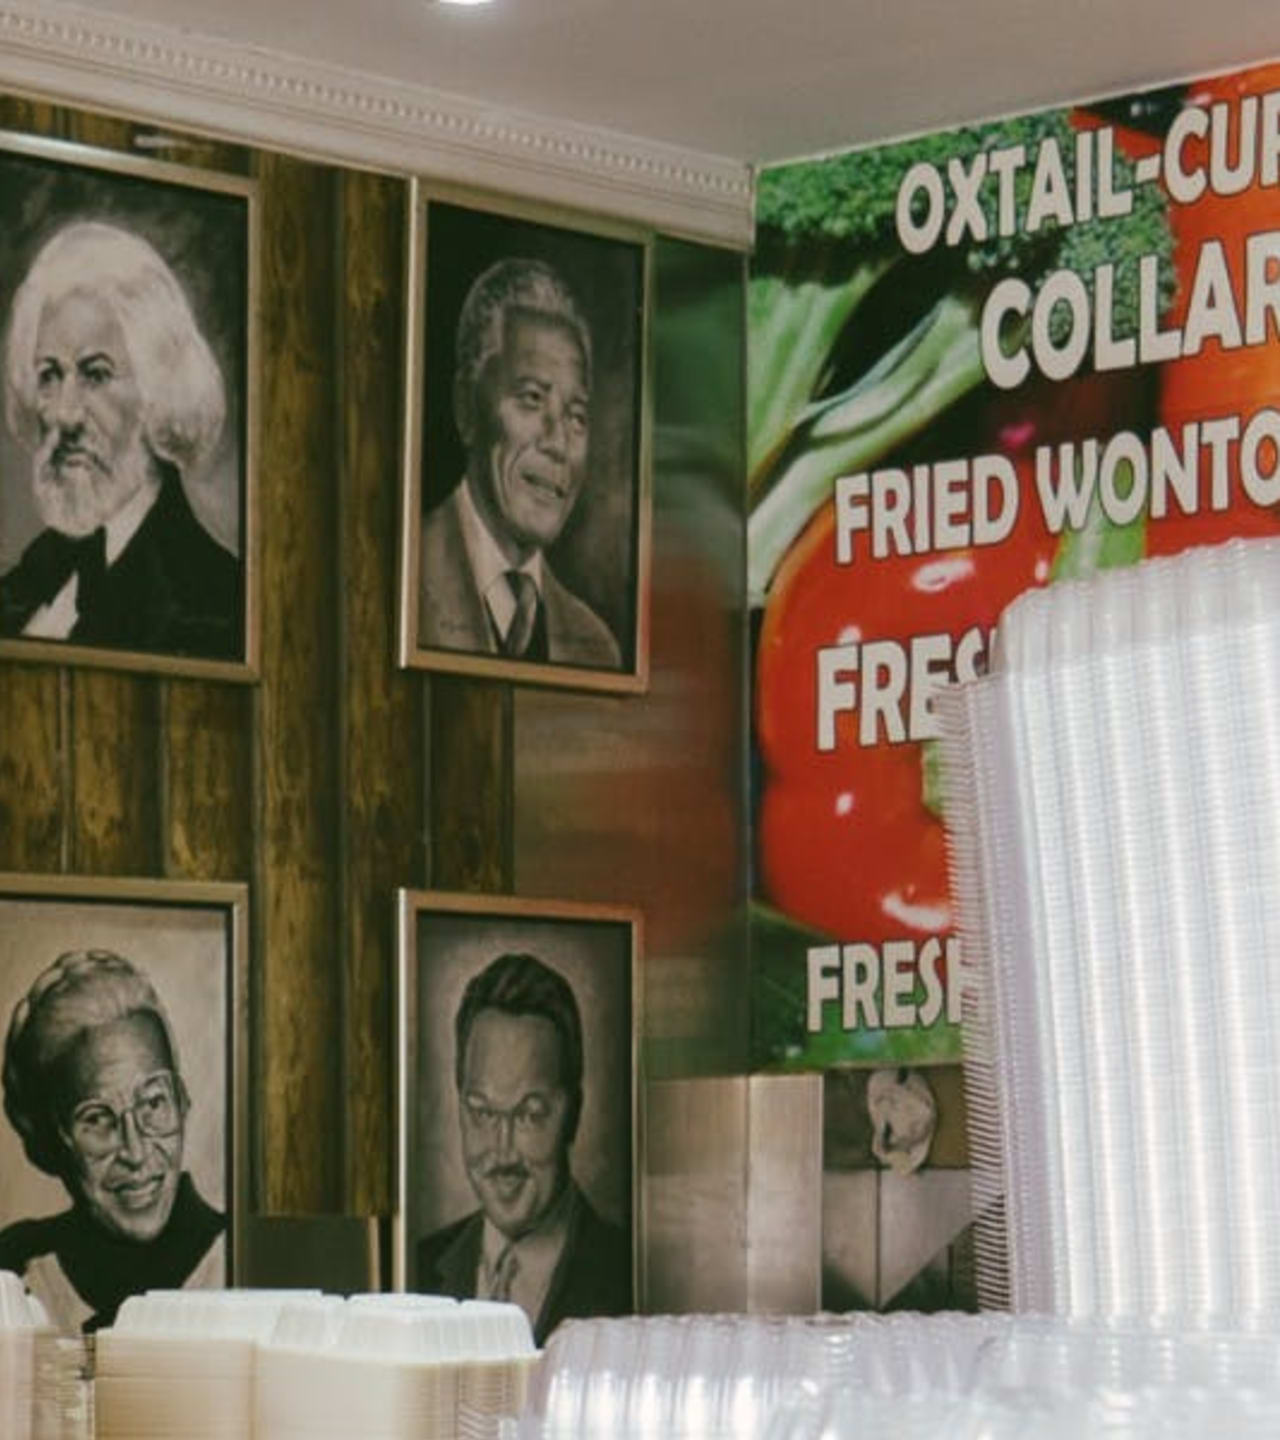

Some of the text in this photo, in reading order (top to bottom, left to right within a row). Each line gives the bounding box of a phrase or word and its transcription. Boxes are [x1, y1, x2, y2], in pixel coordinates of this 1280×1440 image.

[980, 229, 1280, 391] COLLAR
[835, 408, 1280, 565] FRIED WONTO
[816, 626, 1000, 752] FRE
